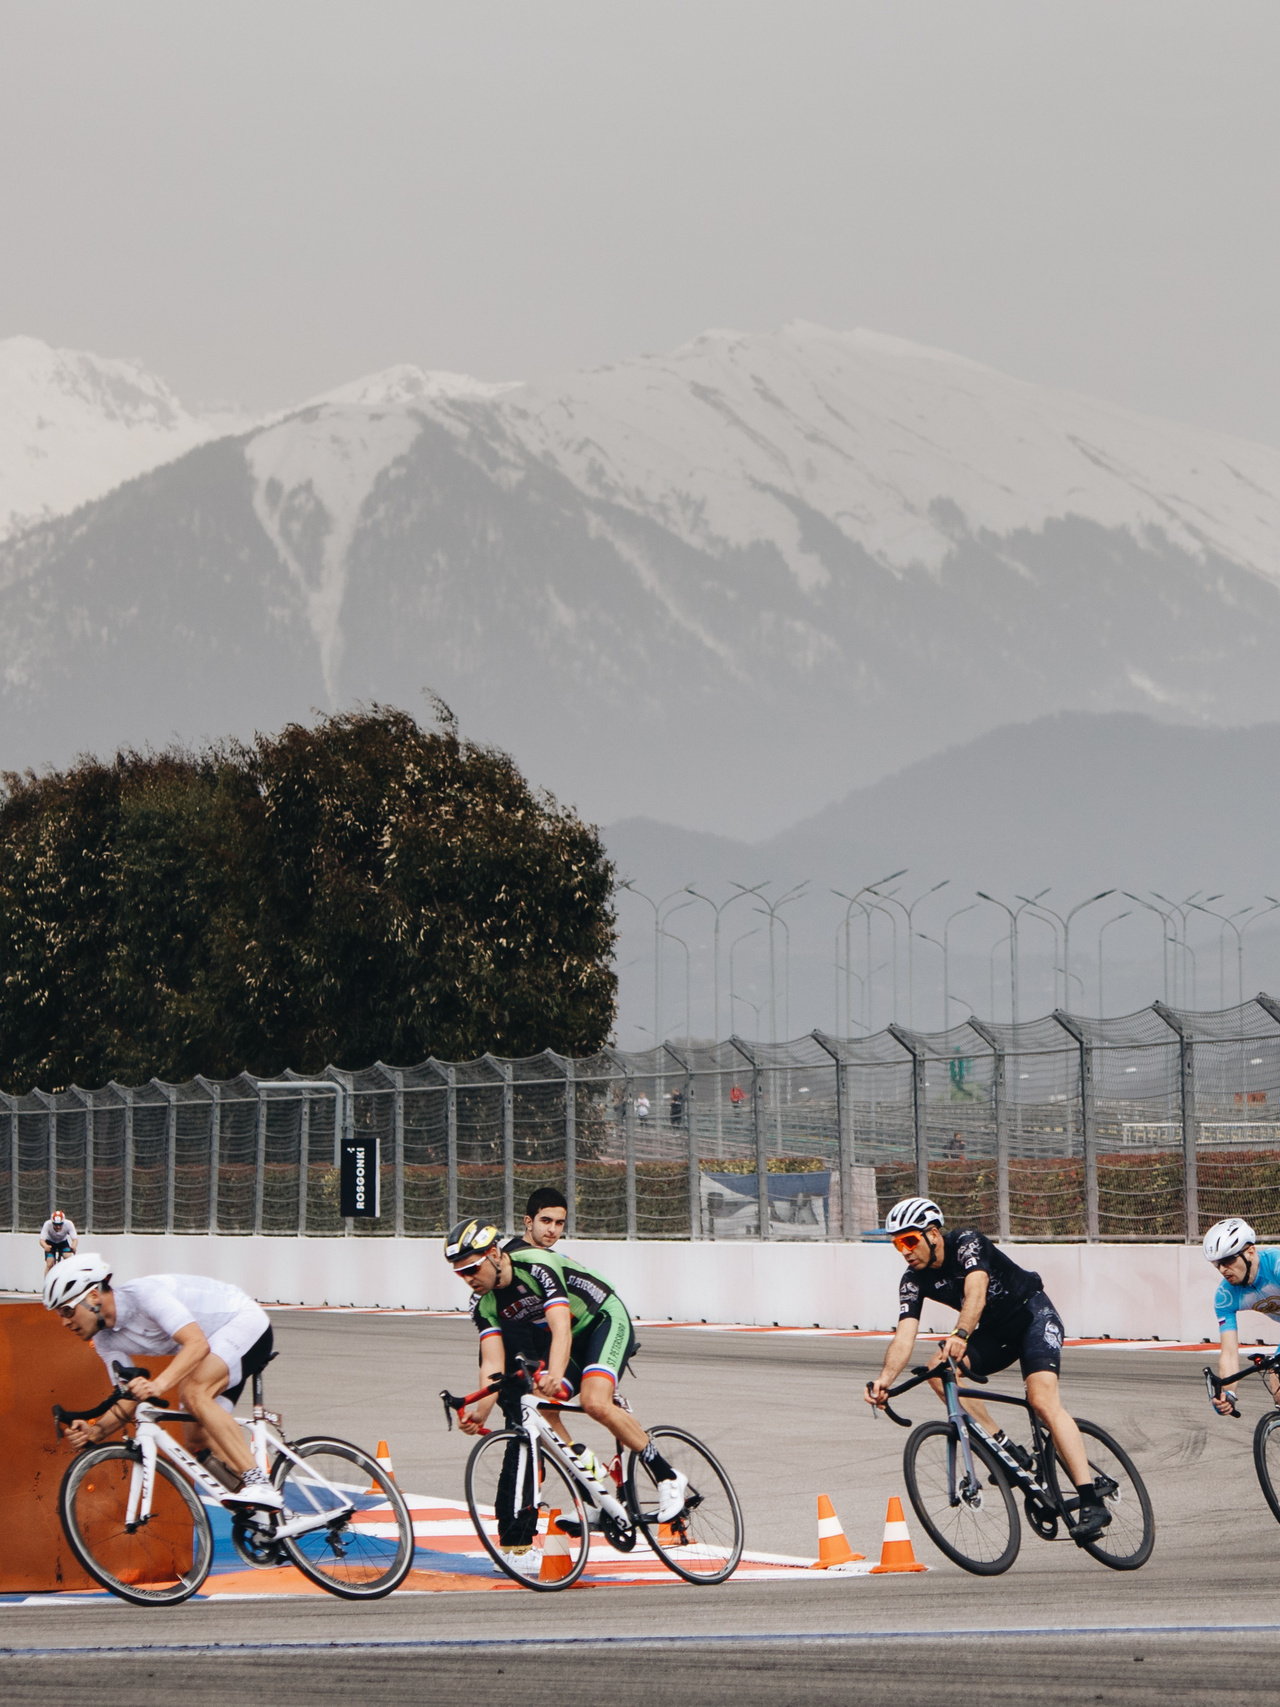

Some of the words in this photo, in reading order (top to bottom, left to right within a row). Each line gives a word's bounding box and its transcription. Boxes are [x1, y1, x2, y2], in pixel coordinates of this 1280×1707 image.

[356, 1147, 365, 1209] ROSGONKI
[531, 1264, 558, 1298] RUSSIA
[167, 1447, 229, 1496] SCOT
[969, 1422, 1047, 1494] SCOTT
